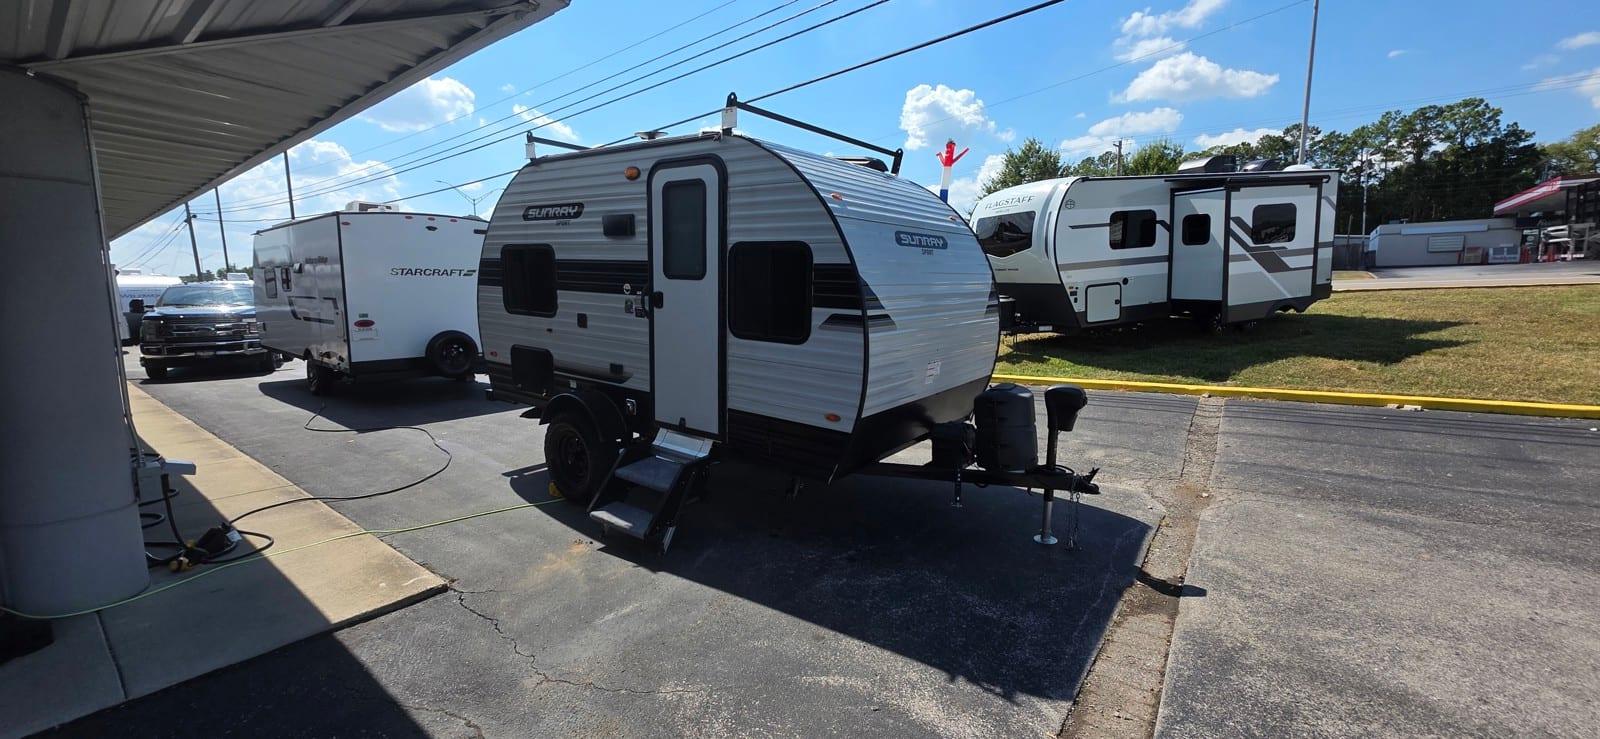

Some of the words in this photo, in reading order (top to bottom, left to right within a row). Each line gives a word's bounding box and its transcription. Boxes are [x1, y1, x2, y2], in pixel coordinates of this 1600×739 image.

[985, 194, 1036, 210] FLAGSTAFF
[527, 205, 579, 219] SUNRAY
[900, 233, 945, 248] SUNRAY
[390, 267, 465, 277] STARCRAFT
